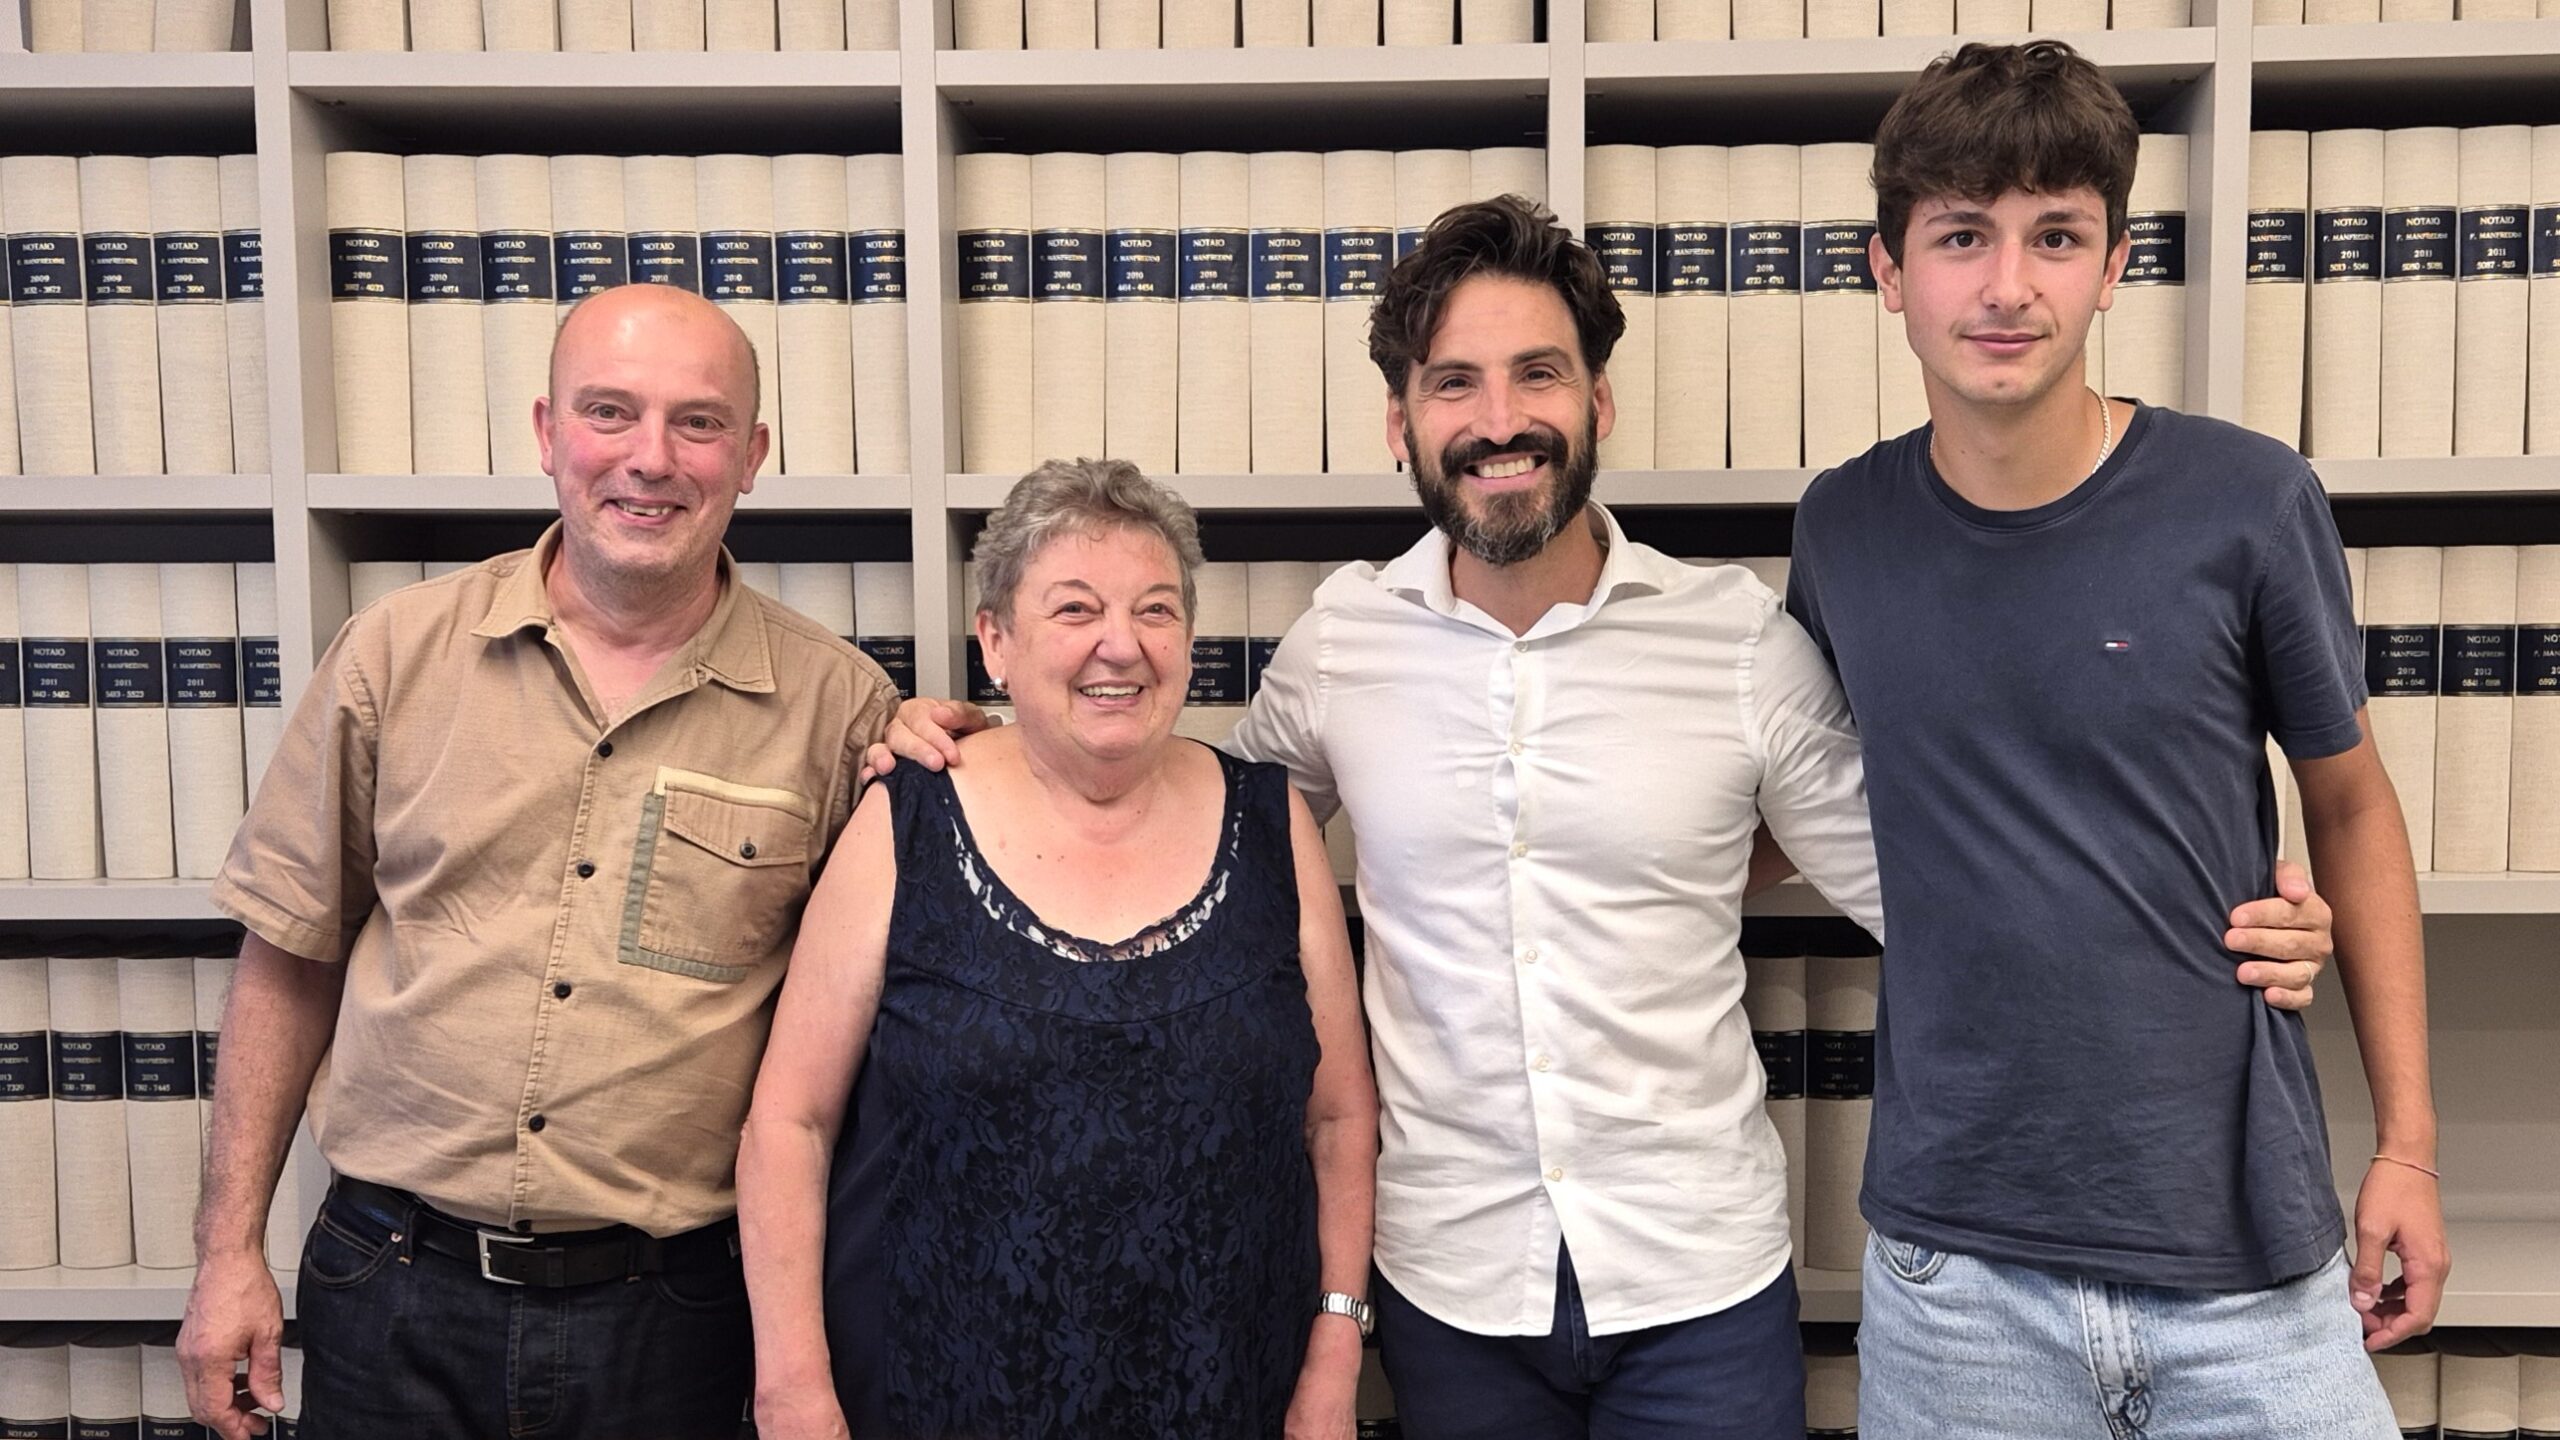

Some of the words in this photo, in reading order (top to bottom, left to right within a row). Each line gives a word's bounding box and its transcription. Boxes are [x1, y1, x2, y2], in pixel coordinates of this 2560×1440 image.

[2250, 219, 2285, 228] NOTAIO
[2333, 217, 2368, 227] NOTAIO
[2406, 217, 2441, 226] NOTAIO
[2479, 216, 2515, 225] NOTAIO
[2130, 222, 2164, 231] NOTAIO
[1603, 232, 1635, 242] NOTAIO
[1674, 232, 1708, 242] NOTAIO
[1748, 231, 1782, 241] NOTAIO
[1825, 231, 1858, 240] NOTAIO
[22, 242, 55, 251] NOTAIO
[96, 242, 128, 251] NOTAIO
[166, 242, 199, 250] NOTAIO
[240, 240, 263, 249] NOTA
[346, 239, 380, 248] NOTAIO
[422, 241, 455, 250] NOTAIO
[494, 240, 526, 249] NOTAIO
[569, 242, 603, 250] NOTAIO
[642, 242, 676, 251] NOTAIO
[716, 242, 750, 250] NOTAIO
[790, 241, 824, 250] NOTAIO
[865, 240, 897, 249] NOTAIO
[973, 239, 1006, 248] NOTAIO
[1047, 238, 1080, 247] NOTAIO
[1120, 239, 1152, 248] NOTAIO
[1192, 238, 1225, 247] NOTAIO
[1268, 238, 1301, 247] NOTAIO
[1341, 238, 1375, 247] NOTAIO
[2258, 252, 2277, 260] 2010
[2340, 250, 2360, 259] 2011
[2413, 249, 2433, 258] 2011
[2486, 248, 2506, 257] 2011
[2137, 254, 2158, 264] 2010
[1609, 265, 1629, 273] 2010
[1681, 265, 1701, 274] 2010
[1755, 264, 1775, 273] 2010
[1833, 264, 1852, 272] 2010
[174, 274, 194, 282] 2009
[353, 271, 373, 279] 2010
[429, 273, 448, 281] 2010
[501, 273, 520, 281] 2010
[577, 274, 597, 282] 2010
[650, 274, 669, 283] 2010
[724, 274, 743, 282] 2010
[798, 274, 817, 282] 2010
[872, 272, 892, 281] 2010
[980, 271, 999, 280] 2010
[1053, 270, 1072, 279] 2010
[1126, 271, 1144, 280] 2010
[1199, 270, 1218, 278] 2010
[1275, 271, 1294, 279] 2010
[1348, 270, 1367, 279] 2010
[30, 275, 51, 283] 2009
[102, 275, 123, 283] 2009
[2390, 634, 2424, 644] NOTAIO
[2466, 635, 2501, 644] NOTAIO
[33, 648, 66, 656] NOTAIO
[106, 648, 140, 657] NOTAIO
[179, 648, 212, 657] NOTAIO
[255, 647, 280, 655] NOTA
[2396, 667, 2416, 675] 2012
[2474, 668, 2492, 676] 2012
[40, 678, 58, 686] 2011
[114, 679, 132, 687] 2011
[186, 678, 204, 686] 2011
[263, 677, 280, 685] 2011
